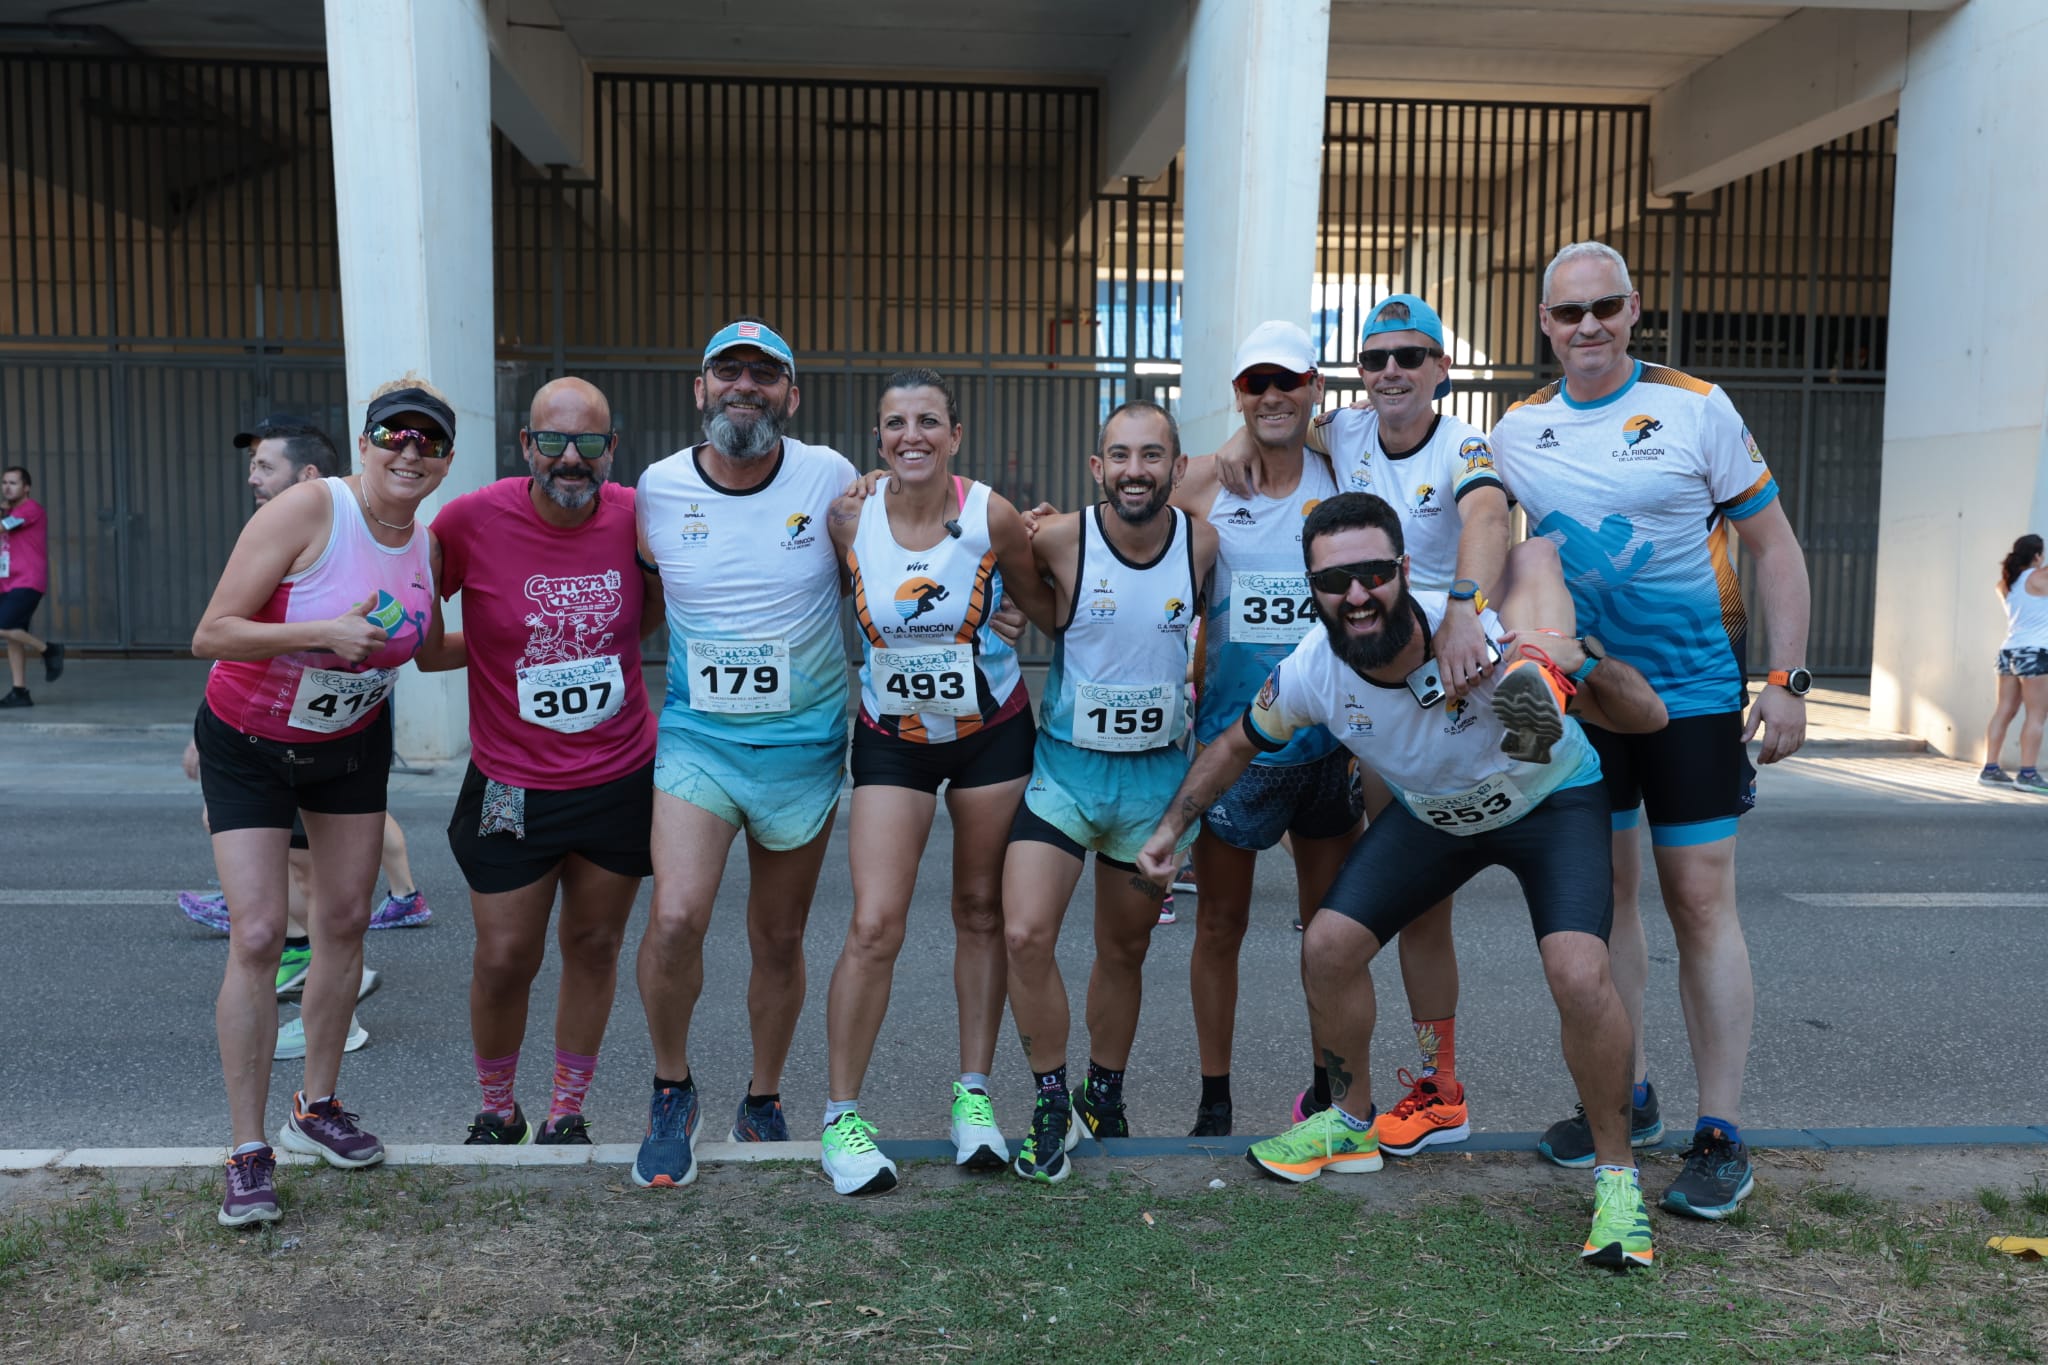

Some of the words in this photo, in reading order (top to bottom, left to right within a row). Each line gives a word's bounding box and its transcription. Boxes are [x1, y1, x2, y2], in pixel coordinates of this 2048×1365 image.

[530, 575, 607, 595] Carrera
[545, 588, 613, 607] Prensa
[1243, 596, 1318, 625] 334
[882, 625, 894, 634] C.
[895, 625, 907, 634] A.
[908, 622, 954, 633] RINCÓN
[700, 665, 778, 694] 179
[886, 671, 965, 700] 493
[307, 684, 388, 717] 418
[533, 681, 612, 718] 307
[1087, 707, 1164, 734] 159
[1427, 792, 1512, 825] 253
